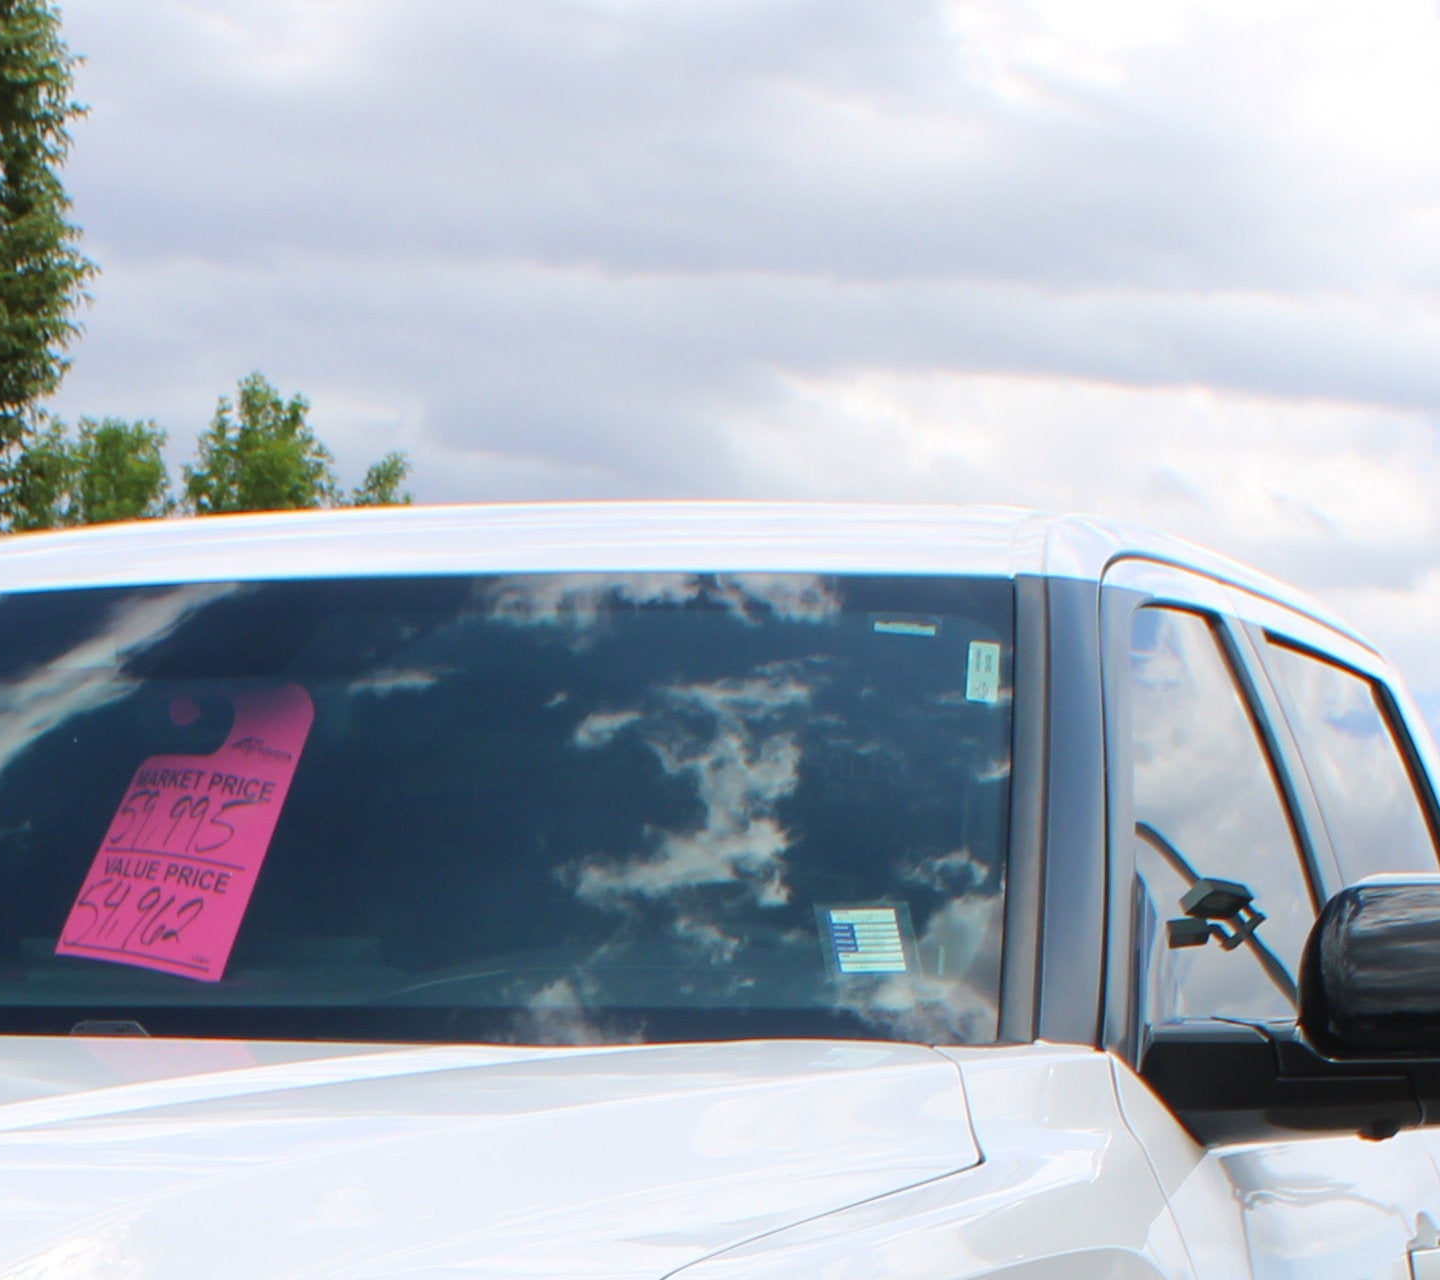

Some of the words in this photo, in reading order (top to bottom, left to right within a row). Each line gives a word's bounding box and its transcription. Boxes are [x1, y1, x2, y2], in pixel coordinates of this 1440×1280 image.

[138, 769, 205, 789] MARKET
[207, 772, 276, 801] PRICE
[104, 857, 161, 880] VALUE
[163, 862, 232, 894] PRICE
